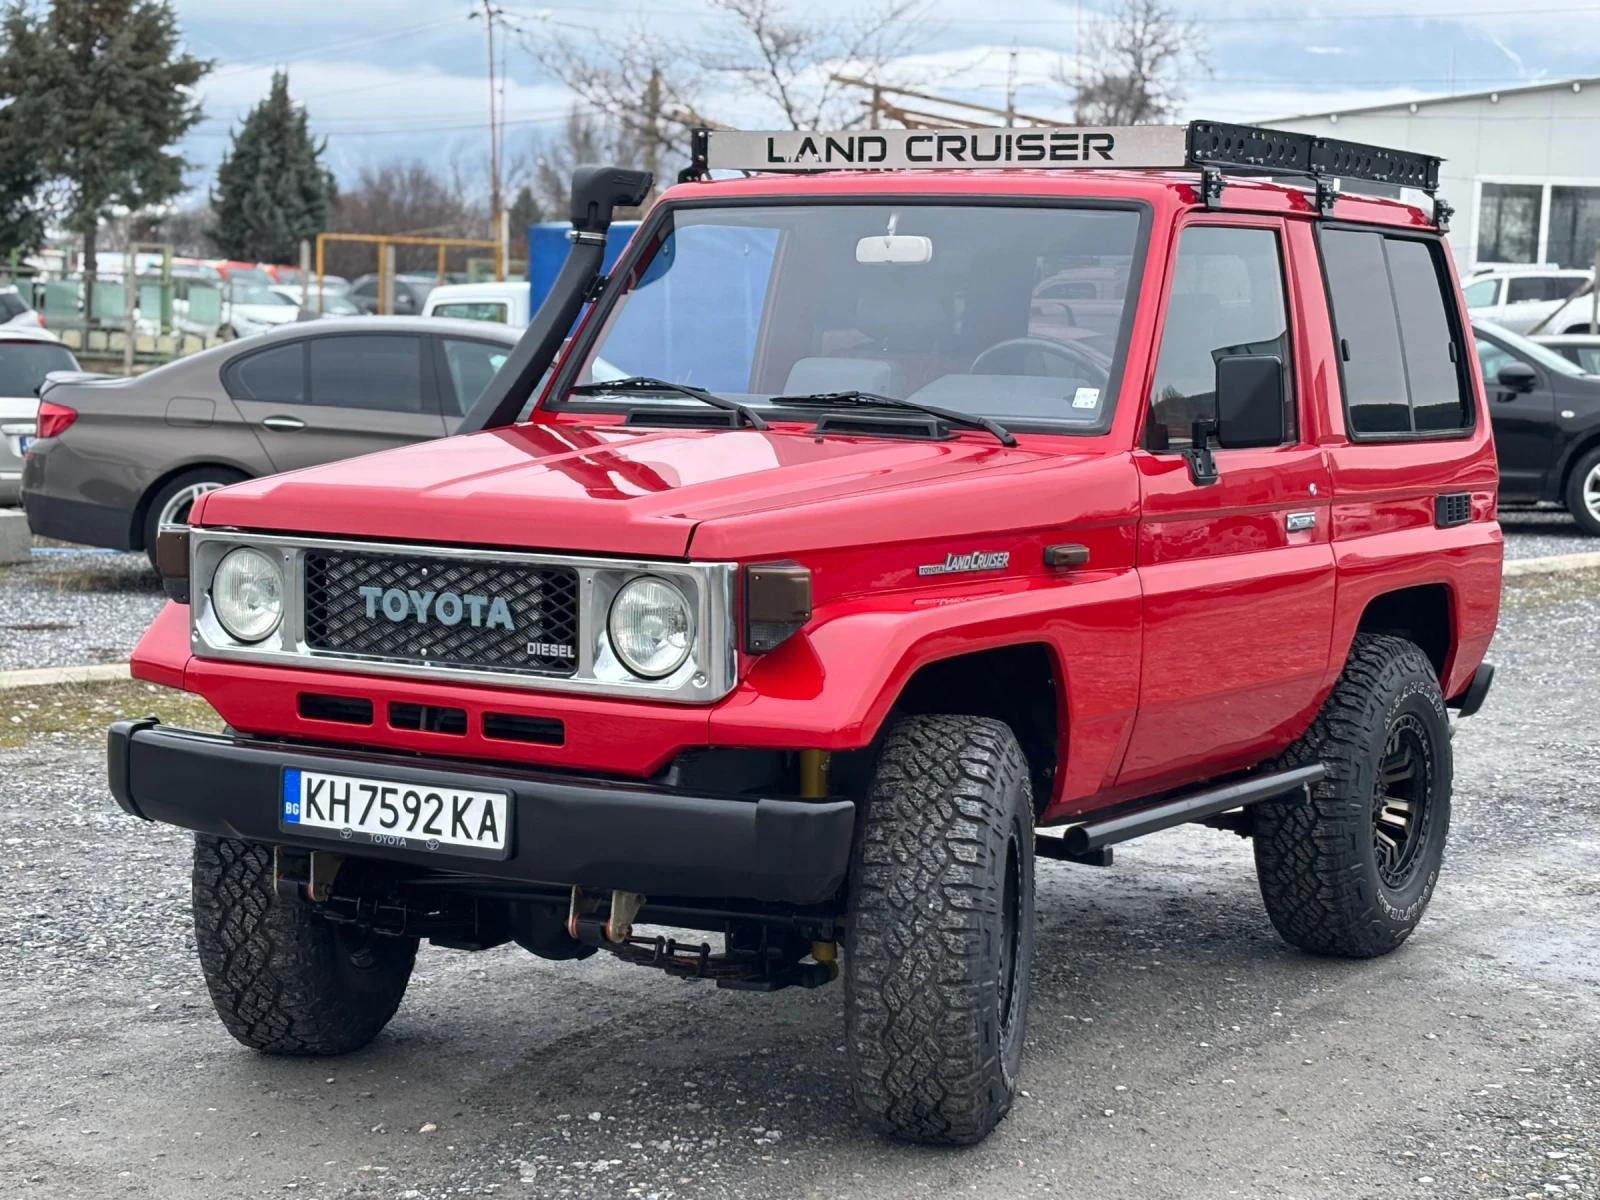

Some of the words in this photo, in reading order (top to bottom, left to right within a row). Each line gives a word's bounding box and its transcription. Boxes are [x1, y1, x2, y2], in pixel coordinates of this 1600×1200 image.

[767, 136, 887, 163] LAND
[905, 133, 1114, 162] CRUISER
[919, 566, 945, 575] TOYOTA
[359, 585, 515, 631] TOYOTA
[527, 642, 575, 659] DIESEL
[1384, 681, 1443, 730] WRANGLER
[285, 801, 300, 816] BG
[368, 832, 407, 848] TOYOTA
